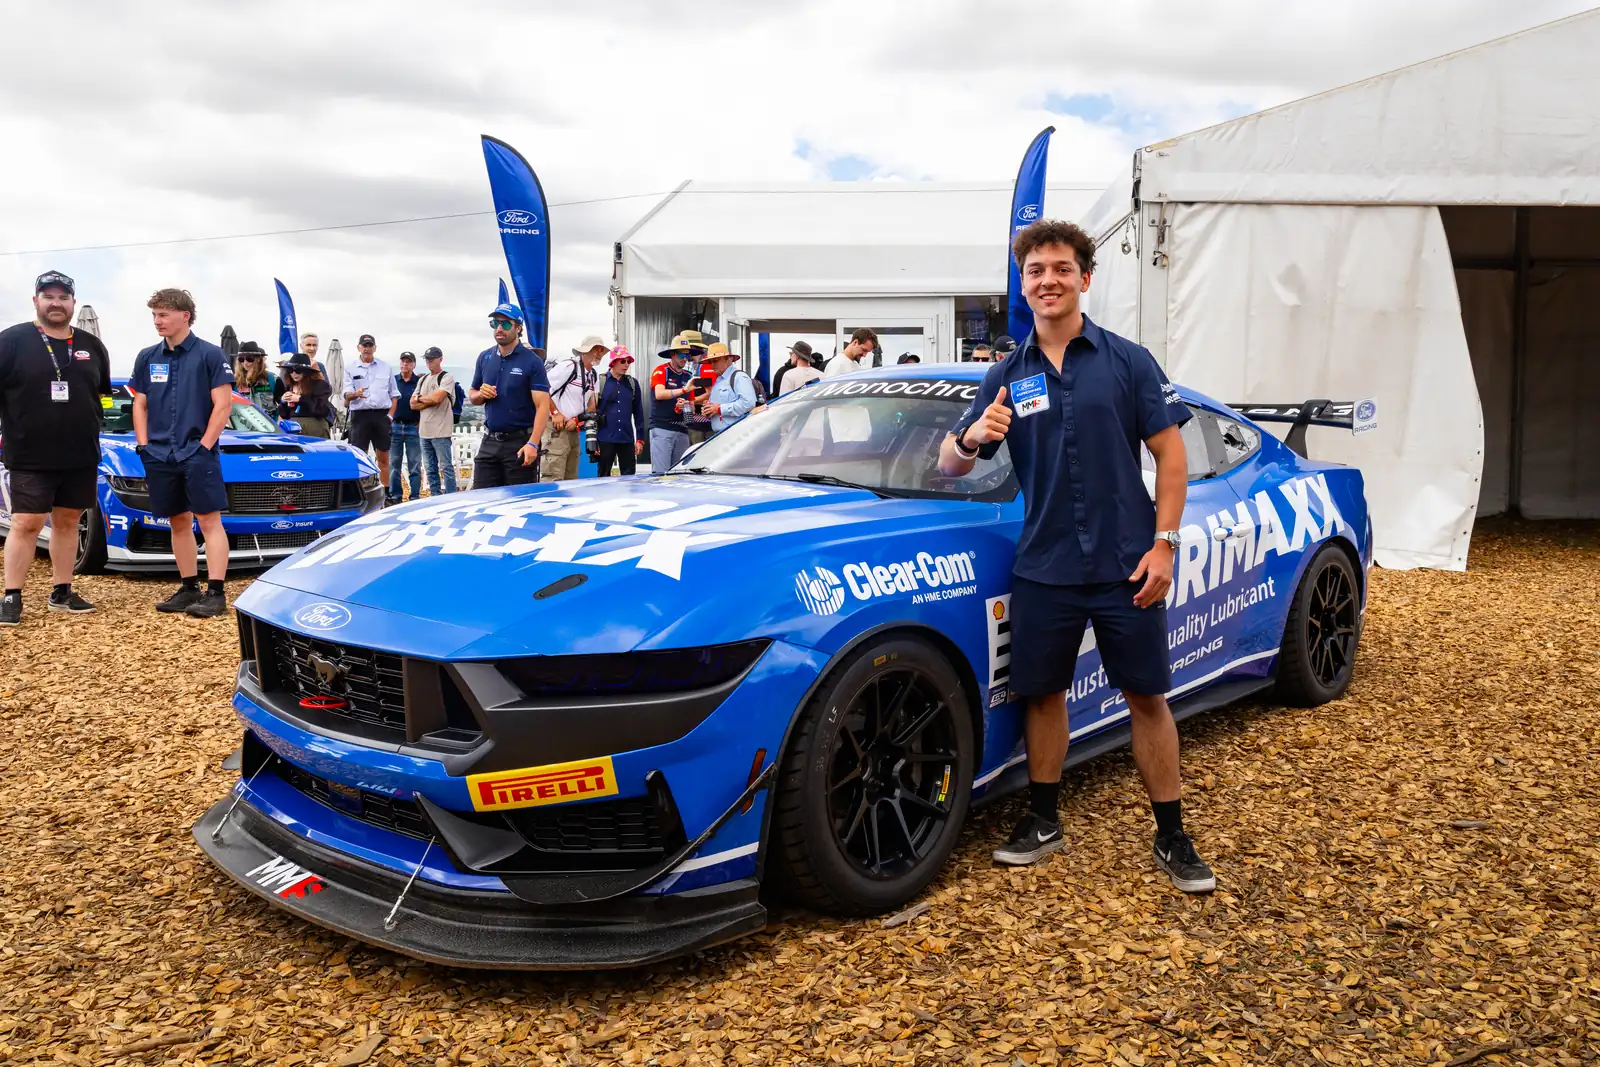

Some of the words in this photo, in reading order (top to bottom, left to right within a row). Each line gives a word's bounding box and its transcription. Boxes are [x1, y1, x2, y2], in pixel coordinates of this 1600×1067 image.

[503, 211, 530, 224] Ford
[1354, 422, 1378, 433] RACING
[294, 520, 314, 528] Insure
[1165, 472, 1346, 611] RIMAXX
[911, 594, 923, 605] AN
[924, 590, 942, 602] HME
[941, 585, 978, 600] COMPANY
[1210, 575, 1276, 628] Lubricant
[1169, 635, 1224, 674] ACING
[476, 765, 606, 806] PIRELLI
